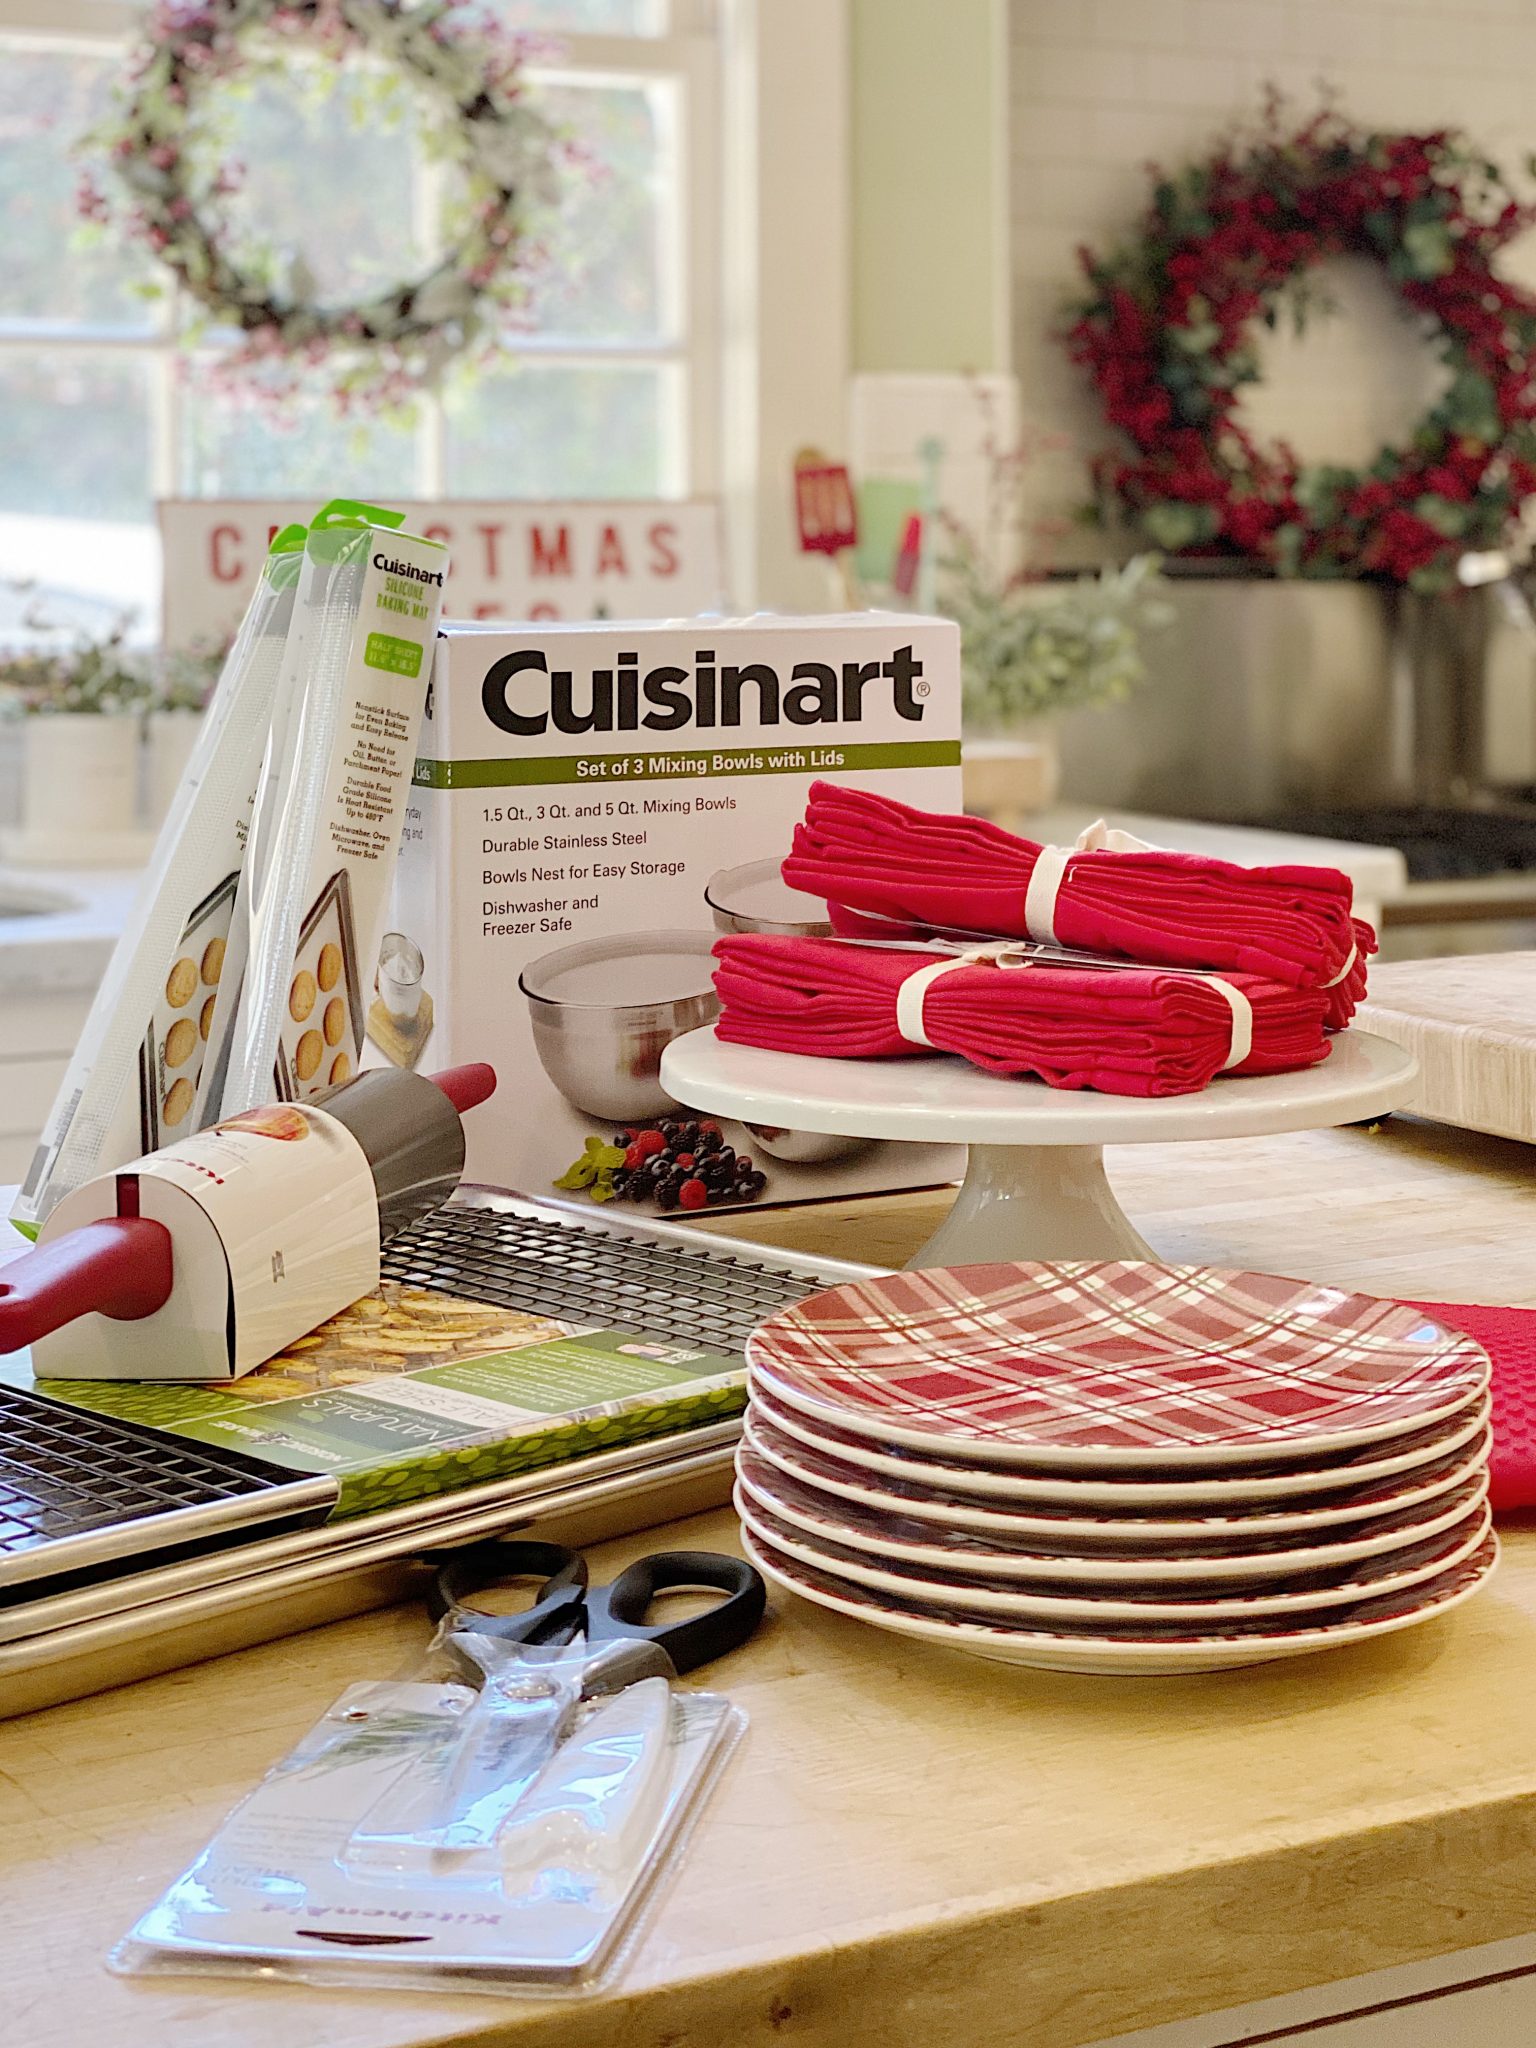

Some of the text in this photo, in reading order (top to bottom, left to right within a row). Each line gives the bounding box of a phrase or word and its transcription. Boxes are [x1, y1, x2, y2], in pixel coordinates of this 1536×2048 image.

[209, 523, 679, 583] CTMAS
[373, 553, 444, 588] Cuisinart
[376, 592, 410, 616] BAKING
[482, 645, 925, 736] Cuisinart
[355, 712, 407, 733] for Even Baking
[386, 708, 410, 721] Surface
[350, 723, 409, 742] and Easy Release
[357, 740, 367, 749] No
[368, 742, 386, 754] Need
[343, 756, 381, 774] Parchment
[416, 764, 431, 781] Lids
[576, 750, 845, 777] Set of 3 Mixing Bowls with Lids
[342, 785, 392, 804] Grade Silicone
[347, 776, 392, 794] Durable Food
[345, 796, 362, 808] Heat
[363, 800, 393, 815] Resistant
[346, 807, 356, 818] Up
[483, 797, 737, 822] 1.5 Qt., 3 Qt. and 5 Qt. Mixing Bowls
[336, 844, 378, 860] Freezer Safe
[371, 843, 385, 851] and
[482, 831, 647, 854] Durable Stainless Steel
[483, 861, 685, 884] Bowls Nest for Easy Storage
[483, 895, 599, 915] Dishwasher and
[483, 917, 572, 936] Freezer Safe
[302, 1398, 453, 1441] NATURALS
